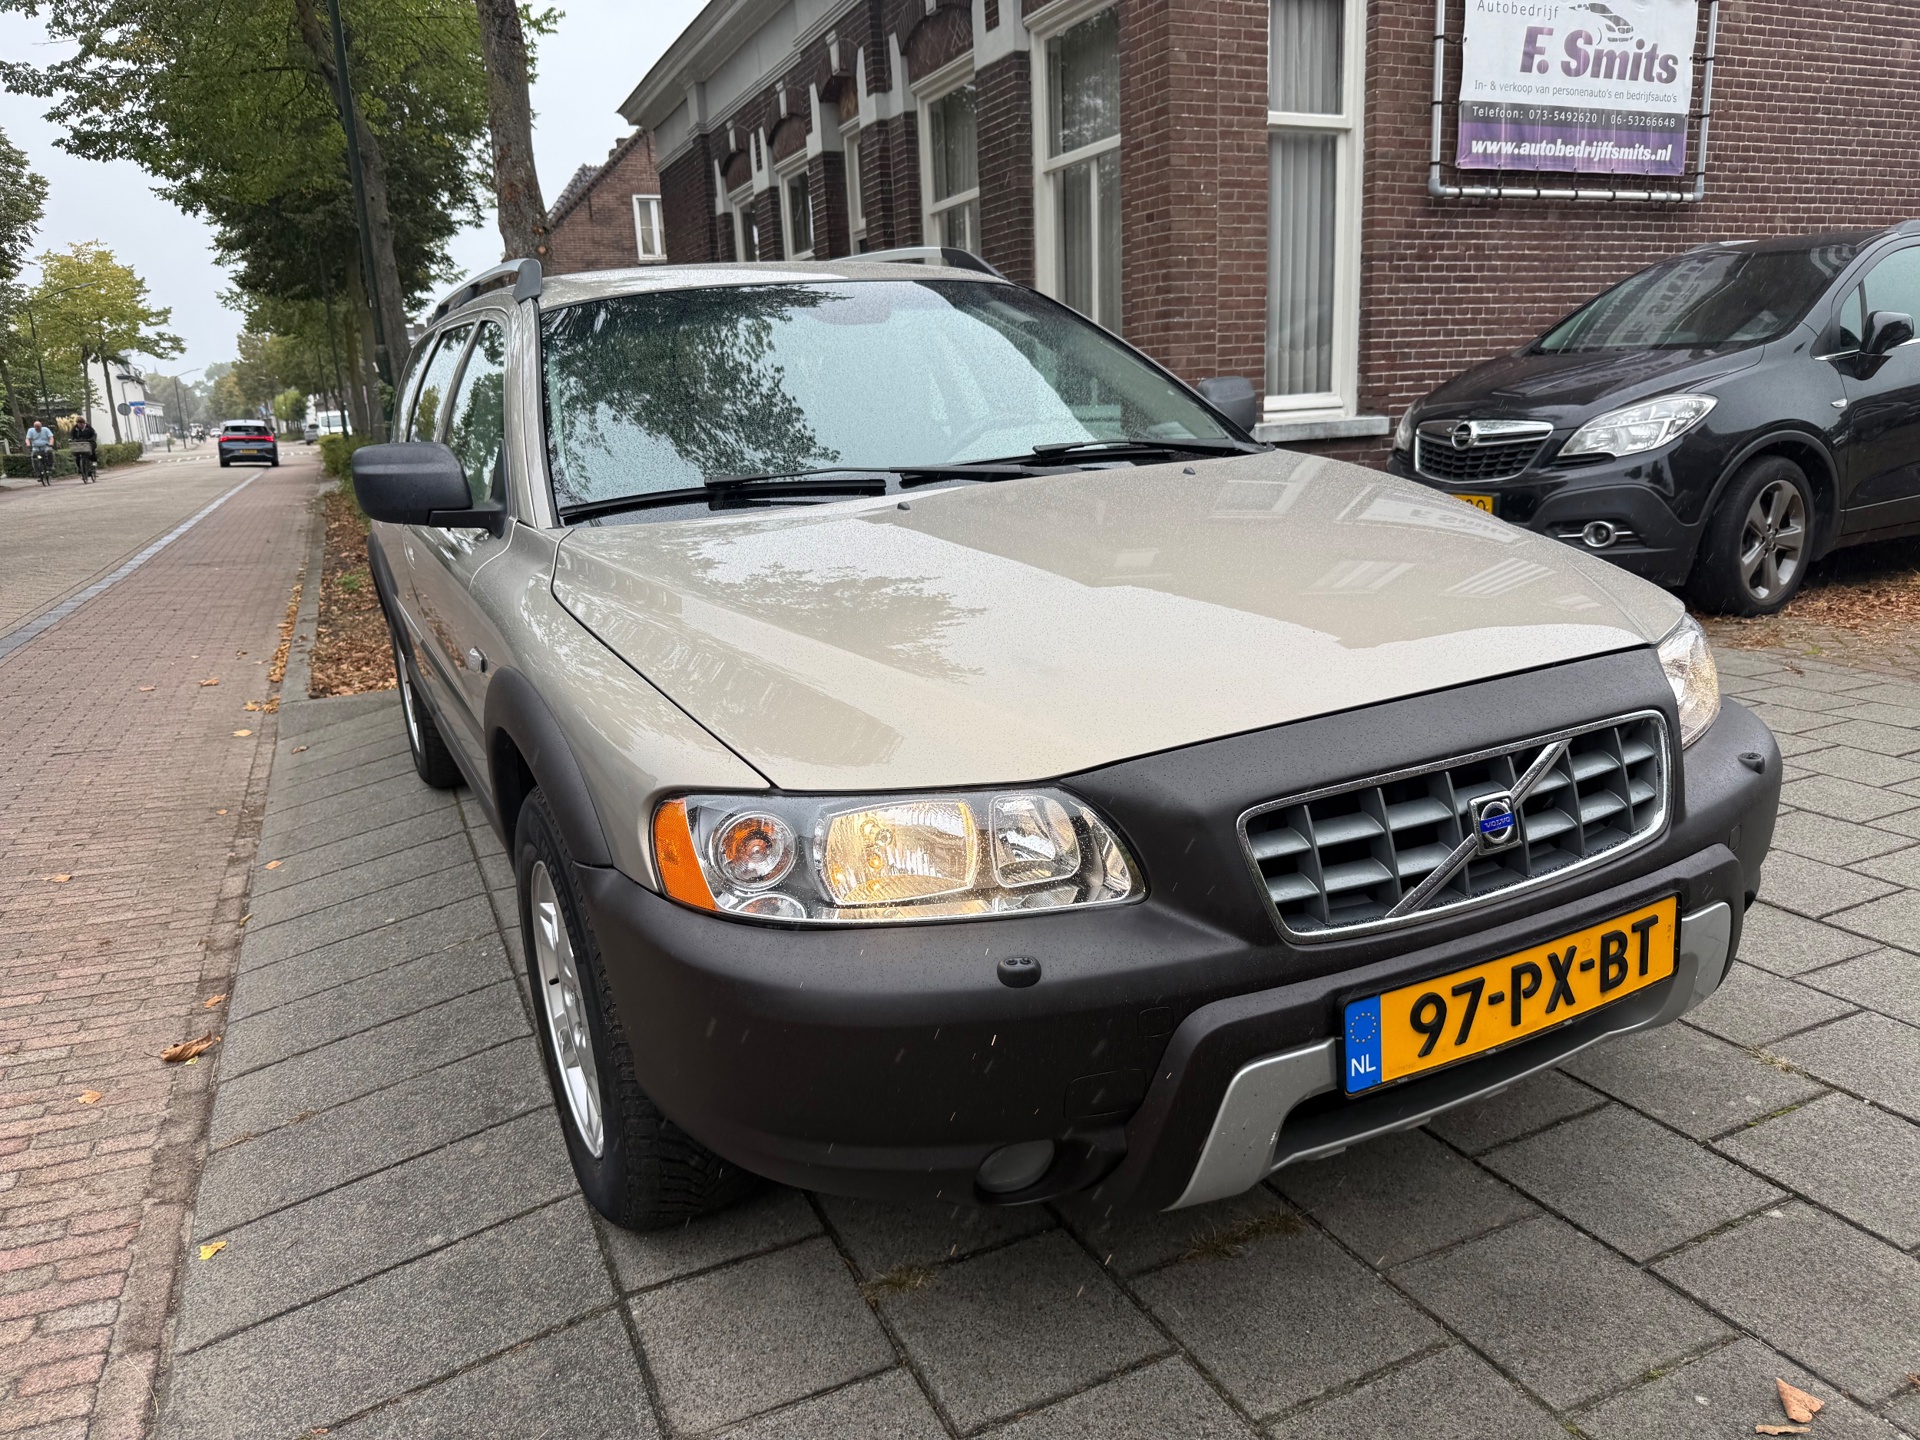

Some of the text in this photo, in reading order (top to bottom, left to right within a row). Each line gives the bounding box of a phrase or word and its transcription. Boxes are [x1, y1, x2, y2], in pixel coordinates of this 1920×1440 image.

[1477, 0, 1559, 21] Autobedrijf
[1519, 26, 1679, 84] F. Smits
[1474, 79, 1677, 103] In- & verkoop van personenauto's en bedrijfsauto's
[1472, 106, 1524, 119] Telefoon:
[1528, 109, 1597, 123] 073-5492620
[1610, 114, 1676, 128] 06-53266648
[1471, 138, 1673, 162] www.autobedrijffsmits.nl
[1484, 816, 1511, 828] VOLVO
[1409, 914, 1659, 1058] 97-PX-BT
[1351, 1053, 1377, 1077] NL
